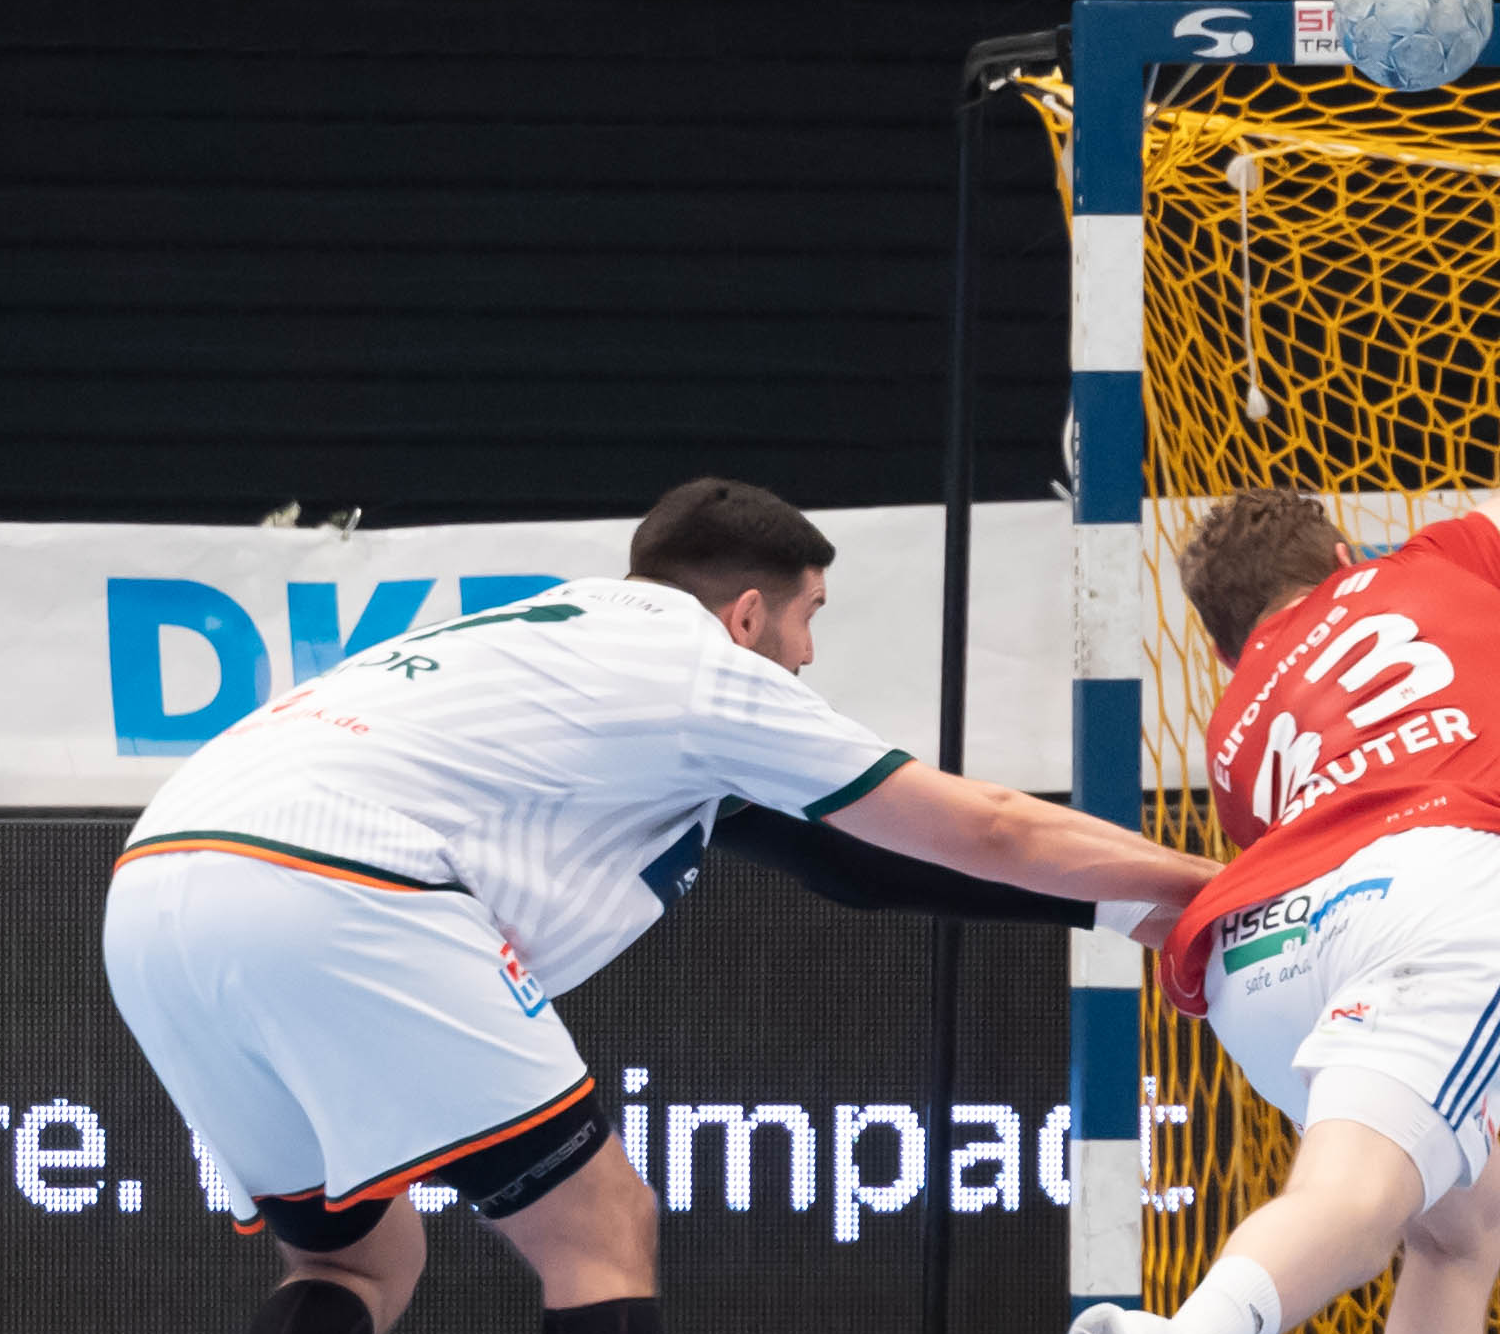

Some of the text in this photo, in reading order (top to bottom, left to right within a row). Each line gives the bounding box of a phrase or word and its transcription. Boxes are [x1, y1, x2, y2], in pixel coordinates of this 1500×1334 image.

[1213, 605, 1348, 793] Eurowings
[1281, 708, 1478, 826] SAUTER
[1221, 895, 1311, 947] HSEQ
